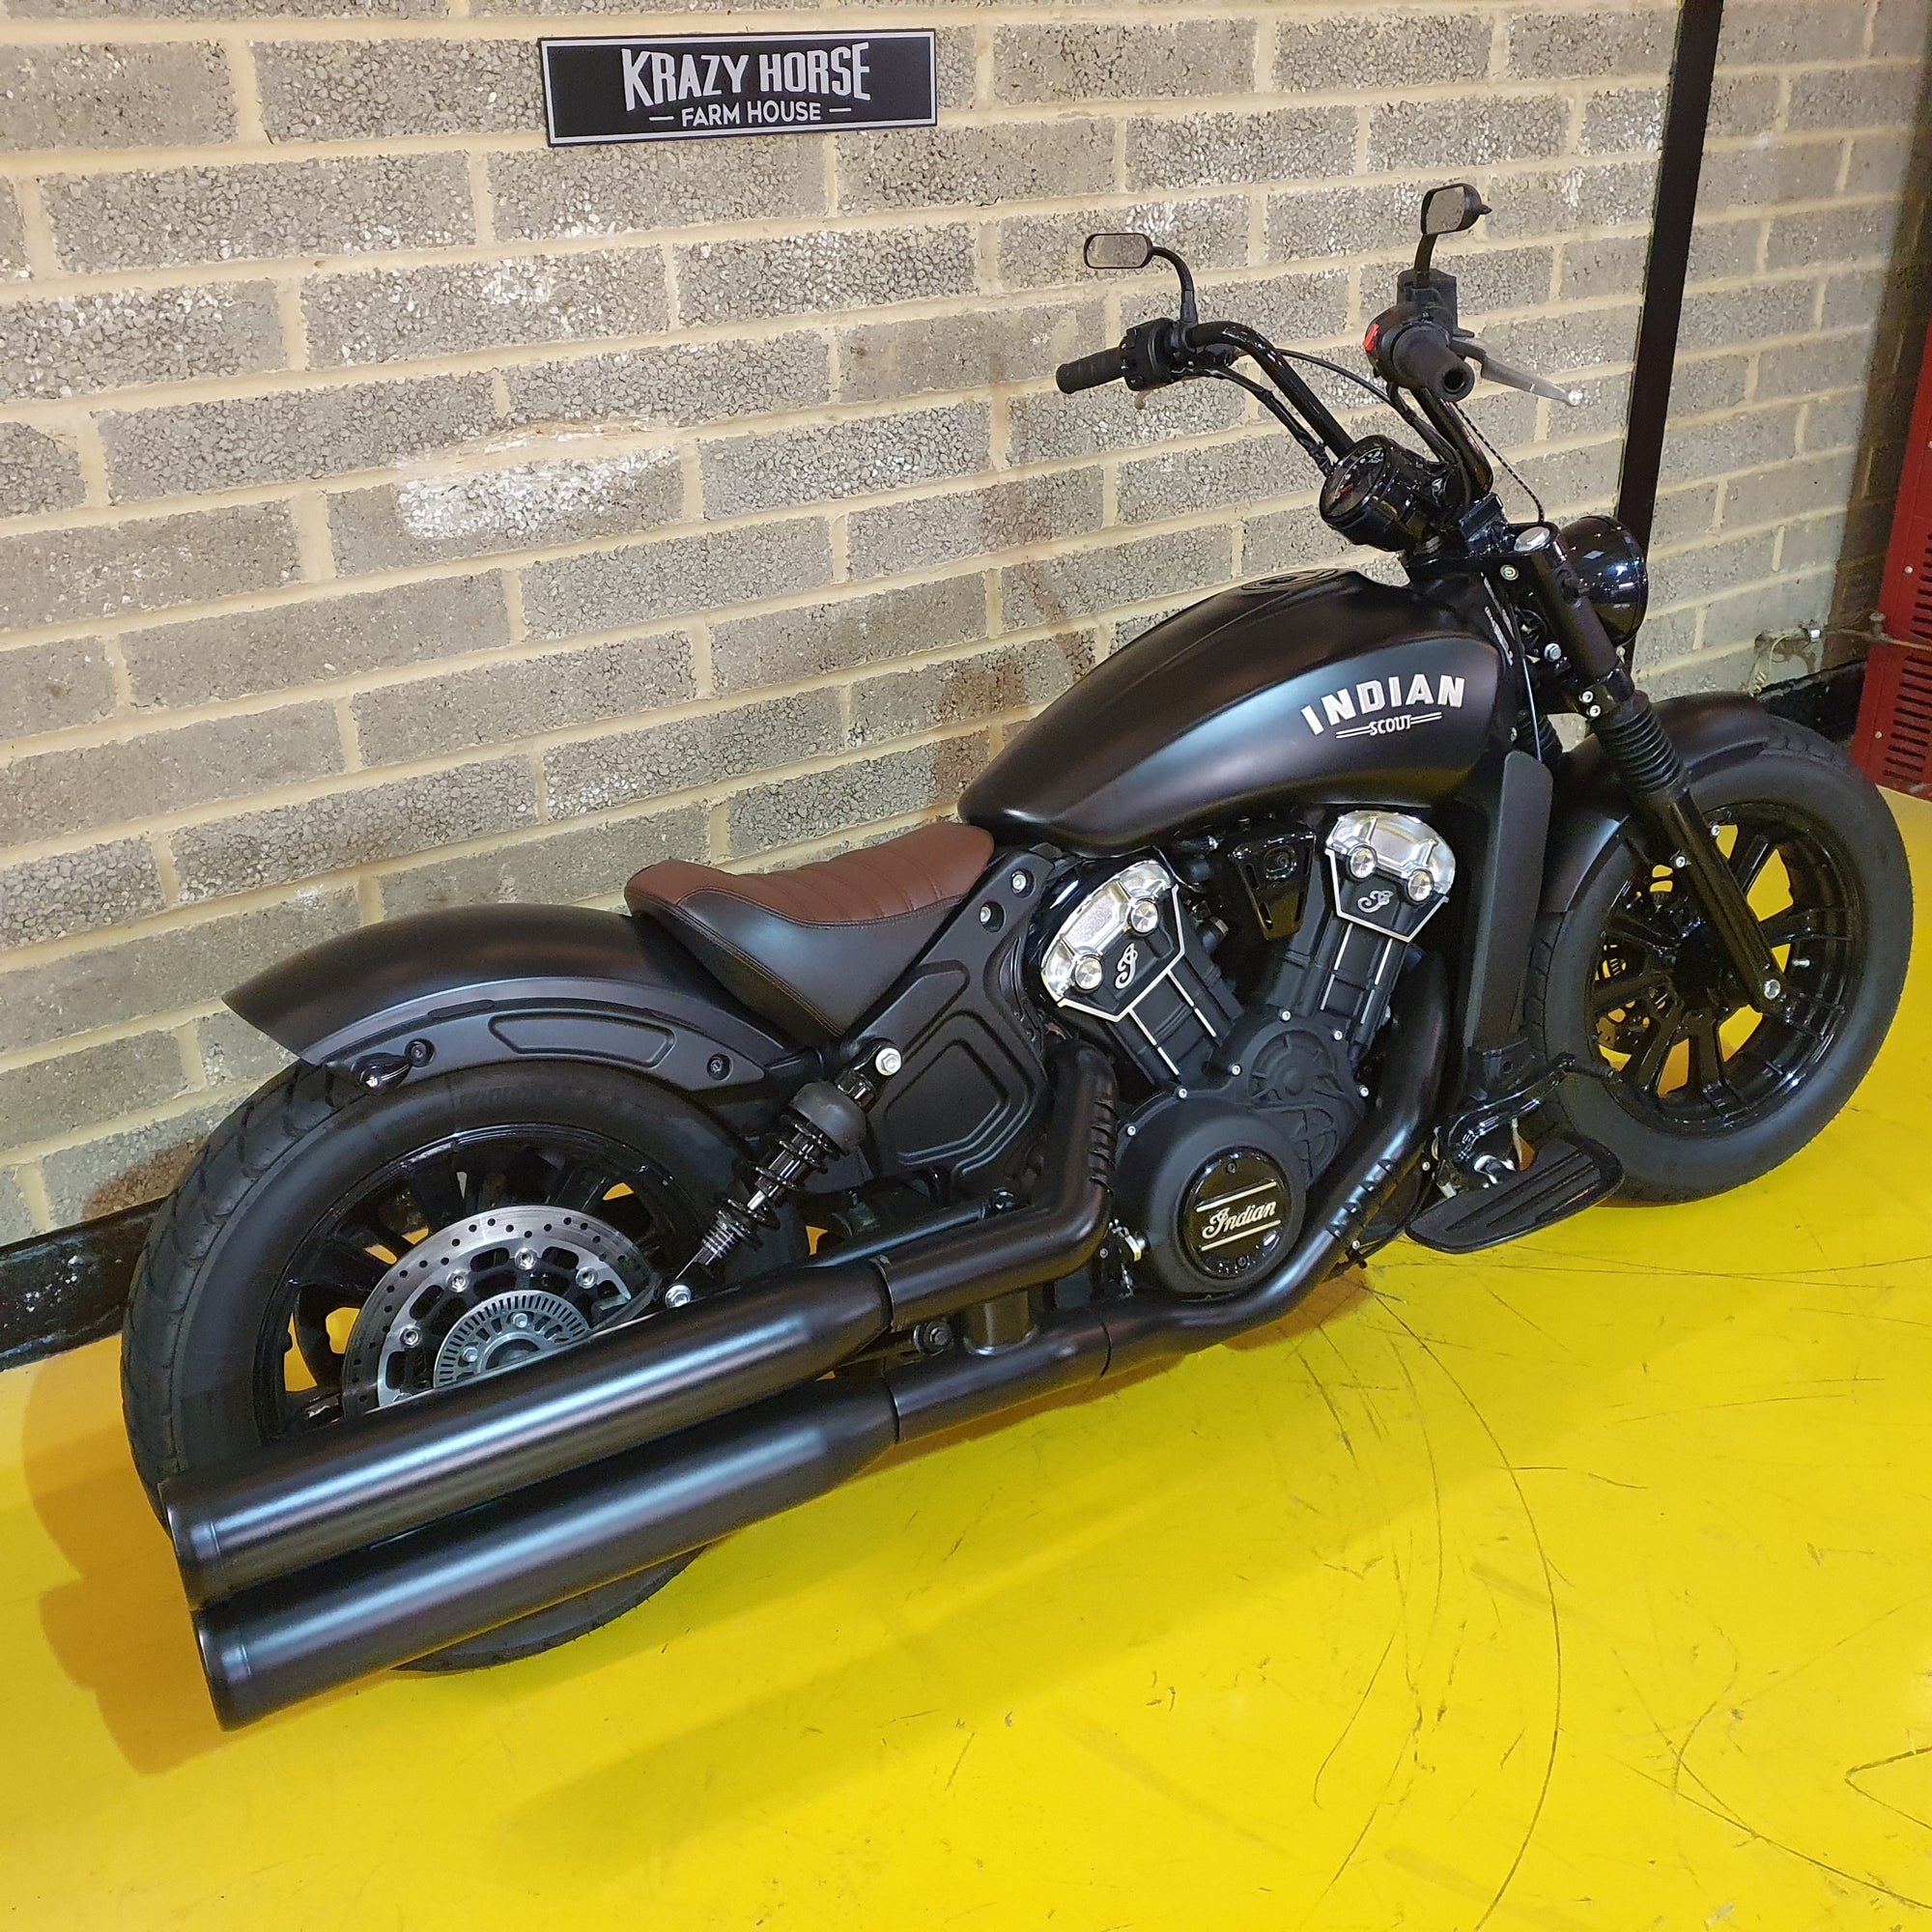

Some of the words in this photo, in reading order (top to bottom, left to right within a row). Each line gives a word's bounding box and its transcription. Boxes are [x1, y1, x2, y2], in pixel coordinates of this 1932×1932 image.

[621, 48, 749, 111] KRAZY
[759, 42, 871, 100] HORSE
[681, 103, 741, 128] FARM
[747, 99, 821, 124] HOUSE
[1300, 673, 1465, 736] INDIAN
[1369, 714, 1411, 736] SCOUT
[1202, 1201, 1276, 1239] Indian
